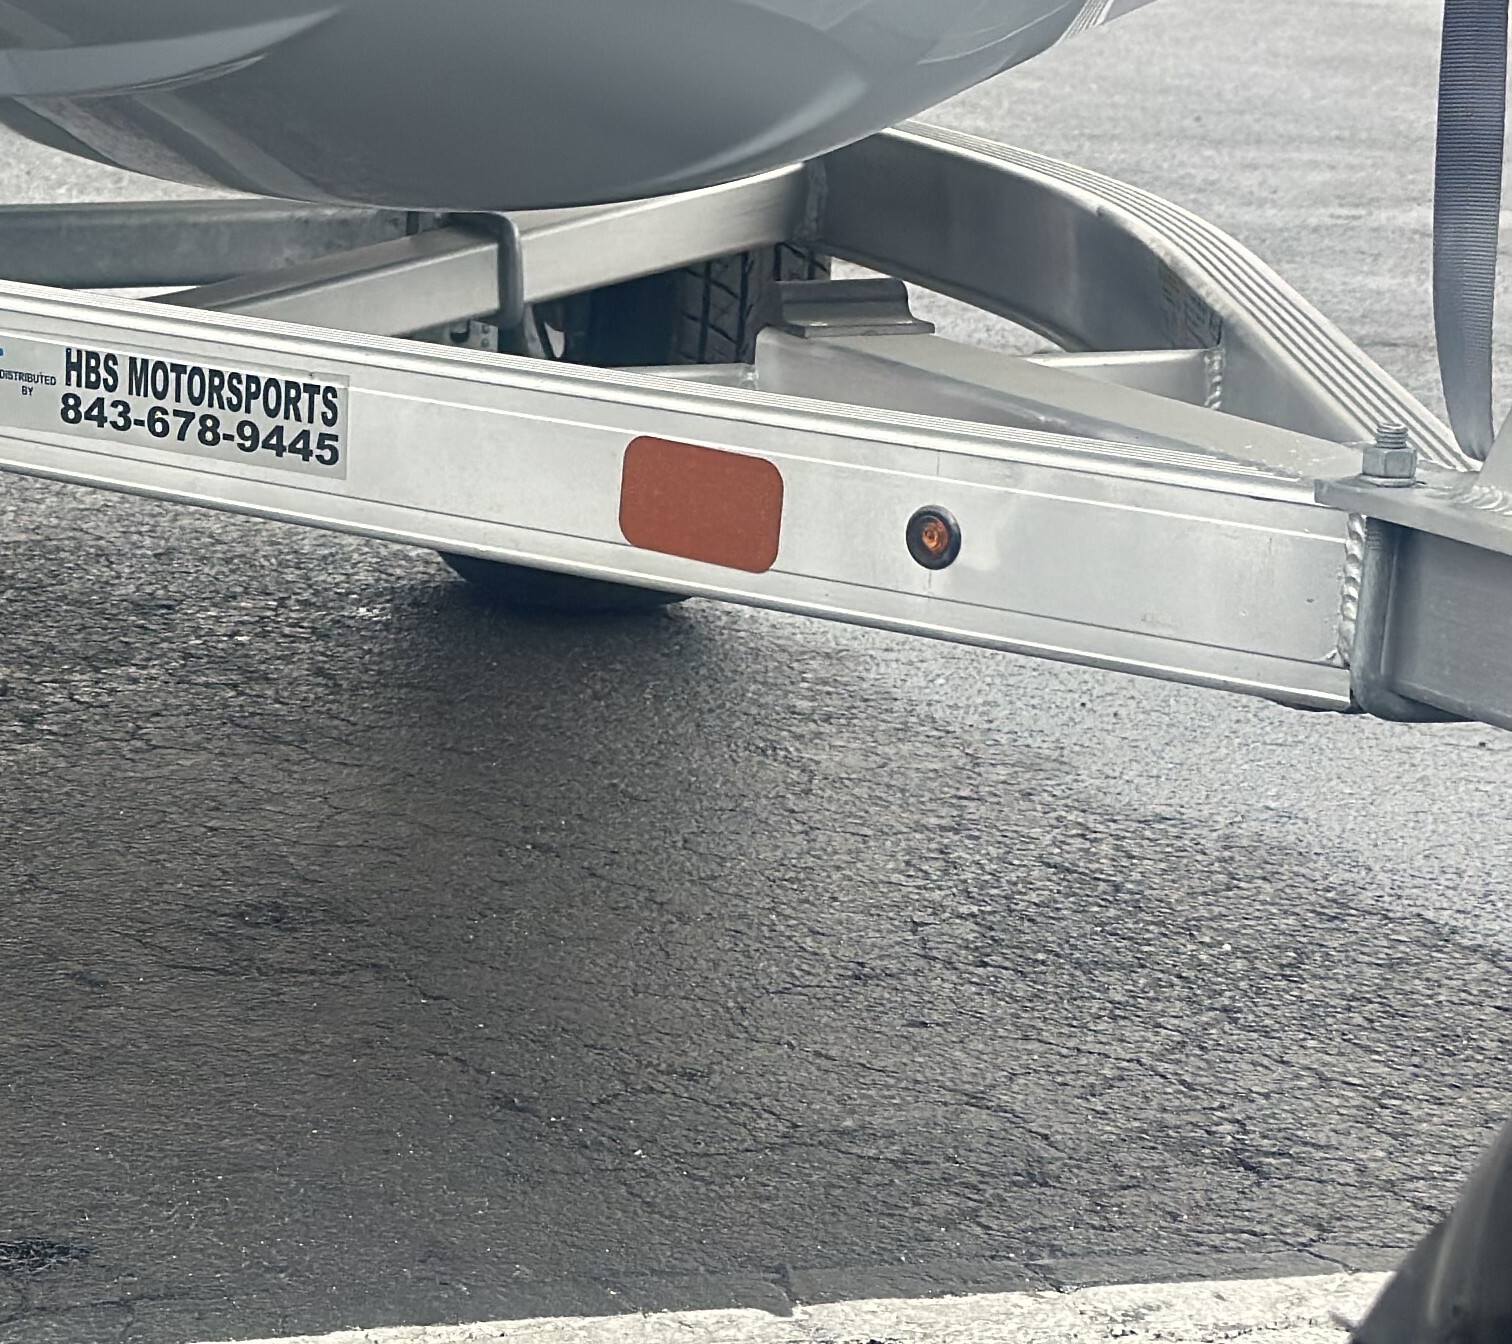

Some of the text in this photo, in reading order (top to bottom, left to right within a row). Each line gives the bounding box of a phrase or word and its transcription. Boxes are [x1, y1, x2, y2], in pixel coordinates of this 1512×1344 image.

[0, 369, 57, 386] DISTRIBUTED
[21, 385, 34, 396] BY
[64, 347, 339, 427] HBS MOTORSPORTS
[60, 393, 340, 466] 843-678-9445
